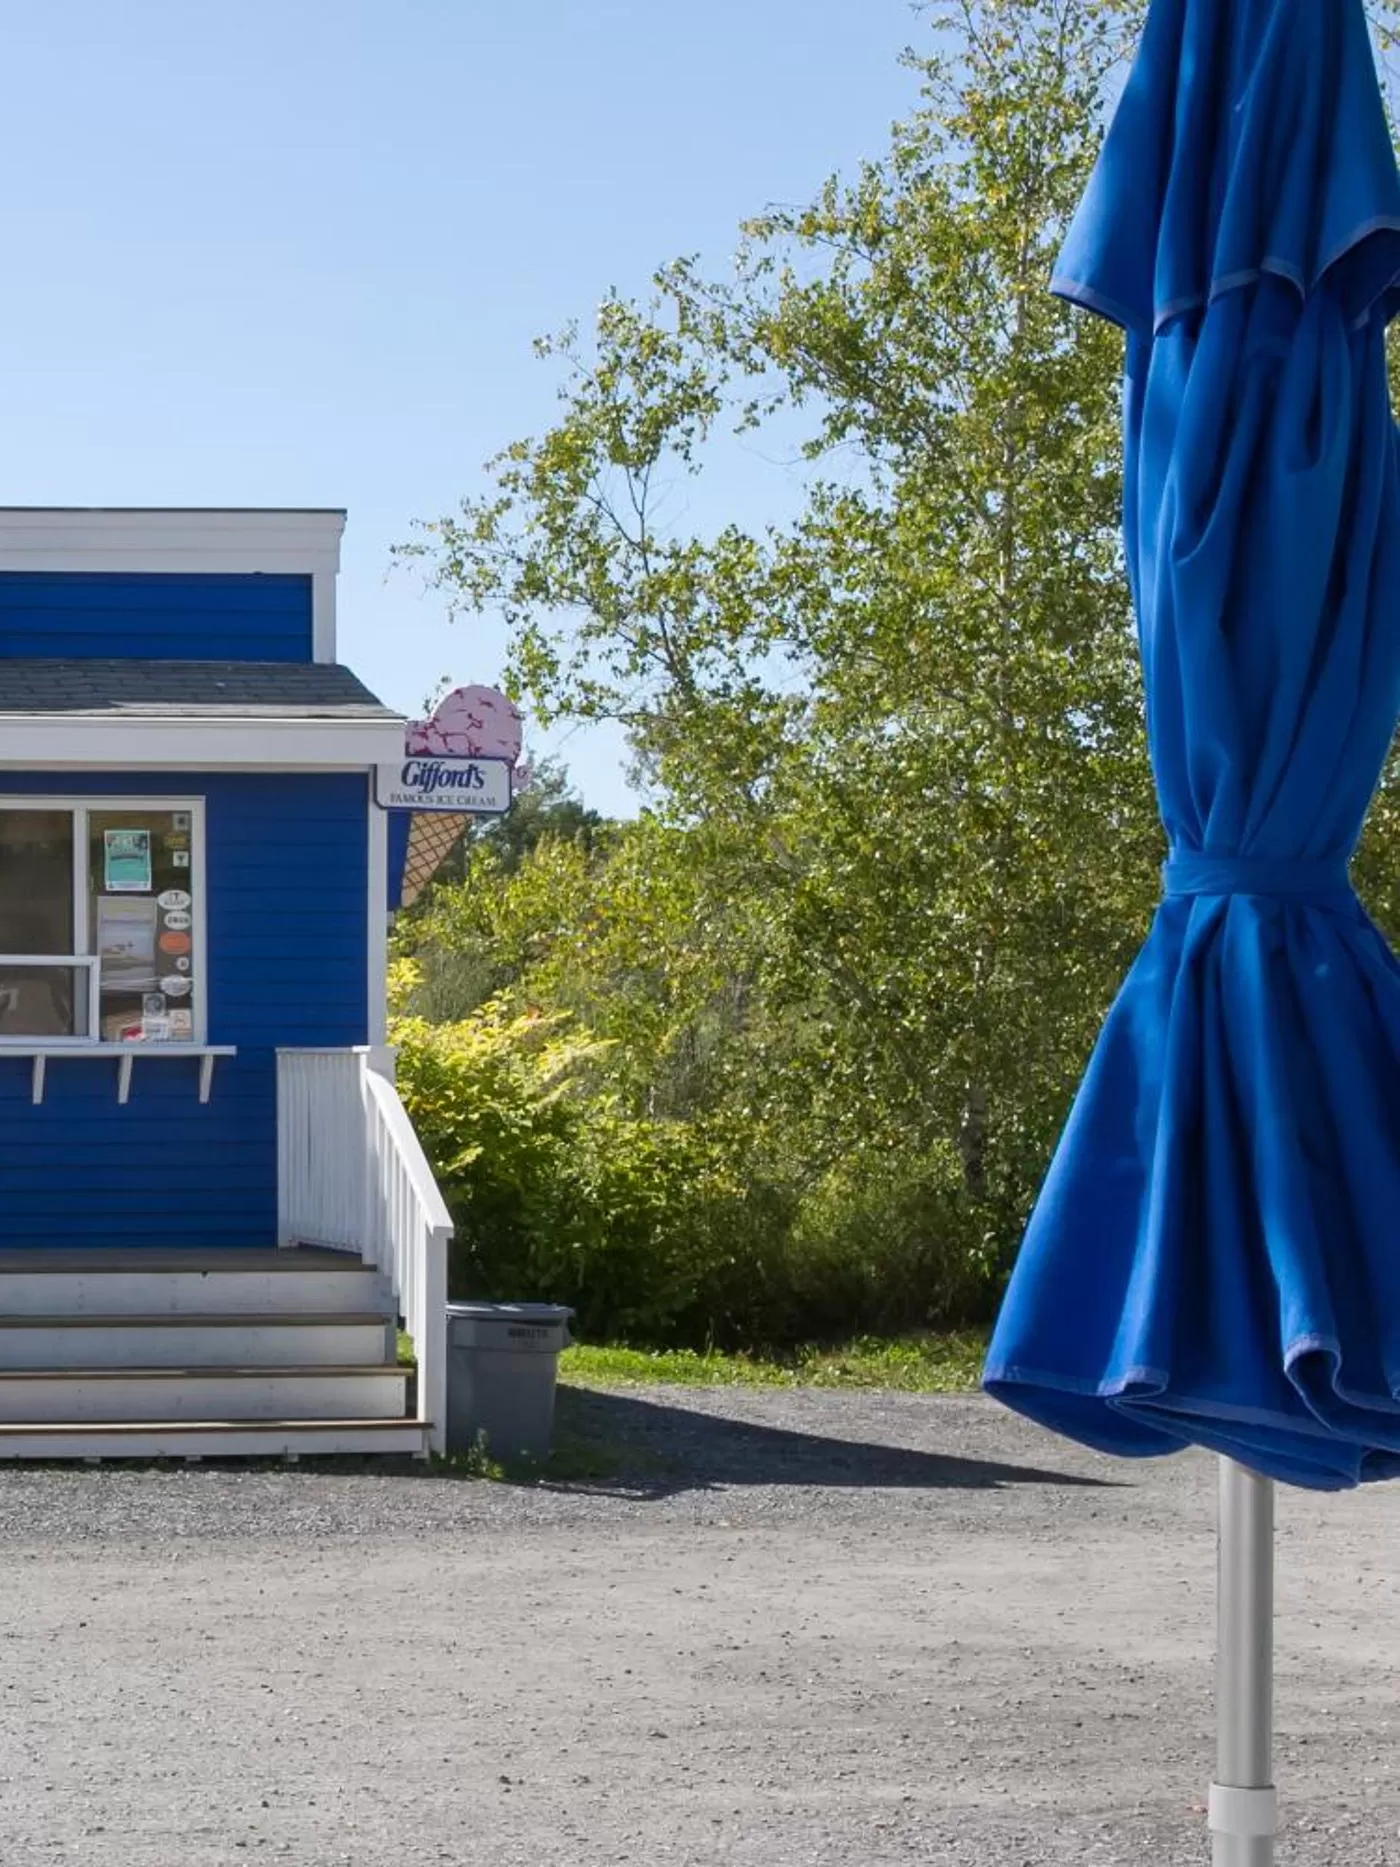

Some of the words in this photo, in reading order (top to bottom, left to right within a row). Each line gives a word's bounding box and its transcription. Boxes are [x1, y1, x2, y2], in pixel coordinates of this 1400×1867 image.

[401, 760, 487, 794] Gifford's
[389, 792, 431, 804] FAMOUS
[435, 793, 454, 805] ICE
[456, 795, 496, 807] CREAM
